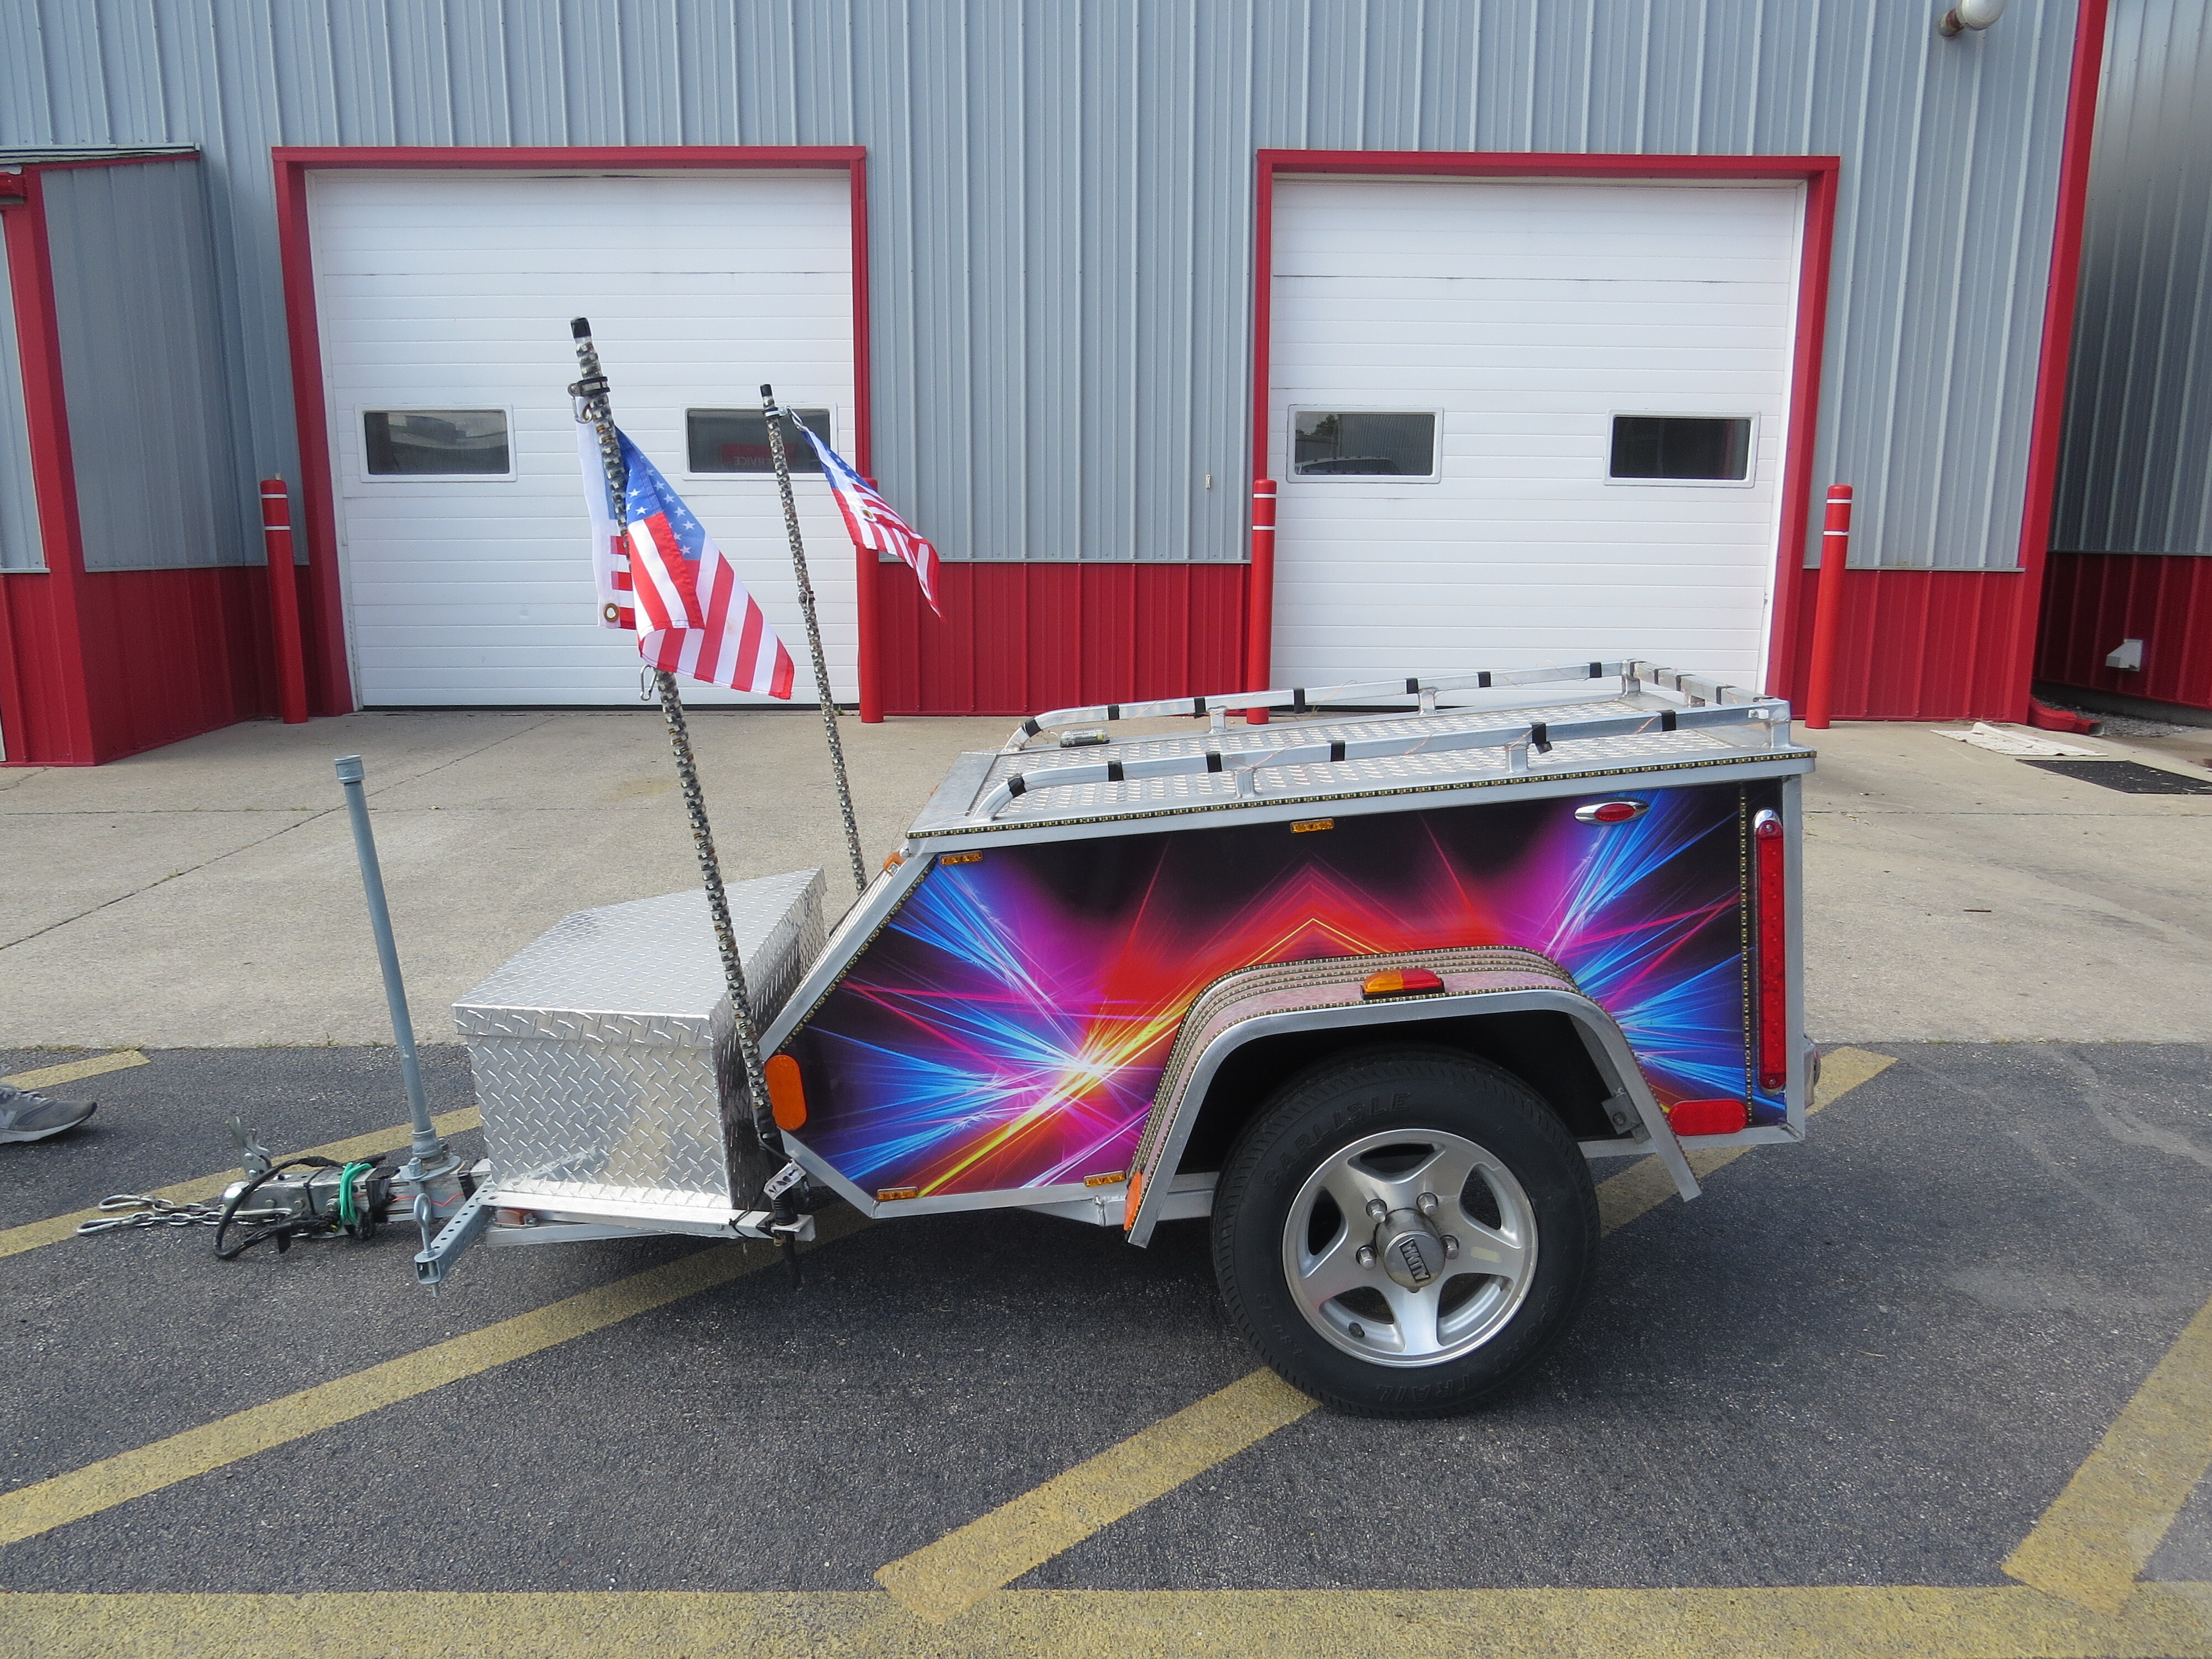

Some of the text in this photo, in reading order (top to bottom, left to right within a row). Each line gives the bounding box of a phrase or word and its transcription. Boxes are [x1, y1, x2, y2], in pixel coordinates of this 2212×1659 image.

[1263, 1093, 1411, 1187] CARLISLE
[1402, 1240, 1429, 1280] ALUMA
[1377, 1374, 1474, 1402] TRAIL
